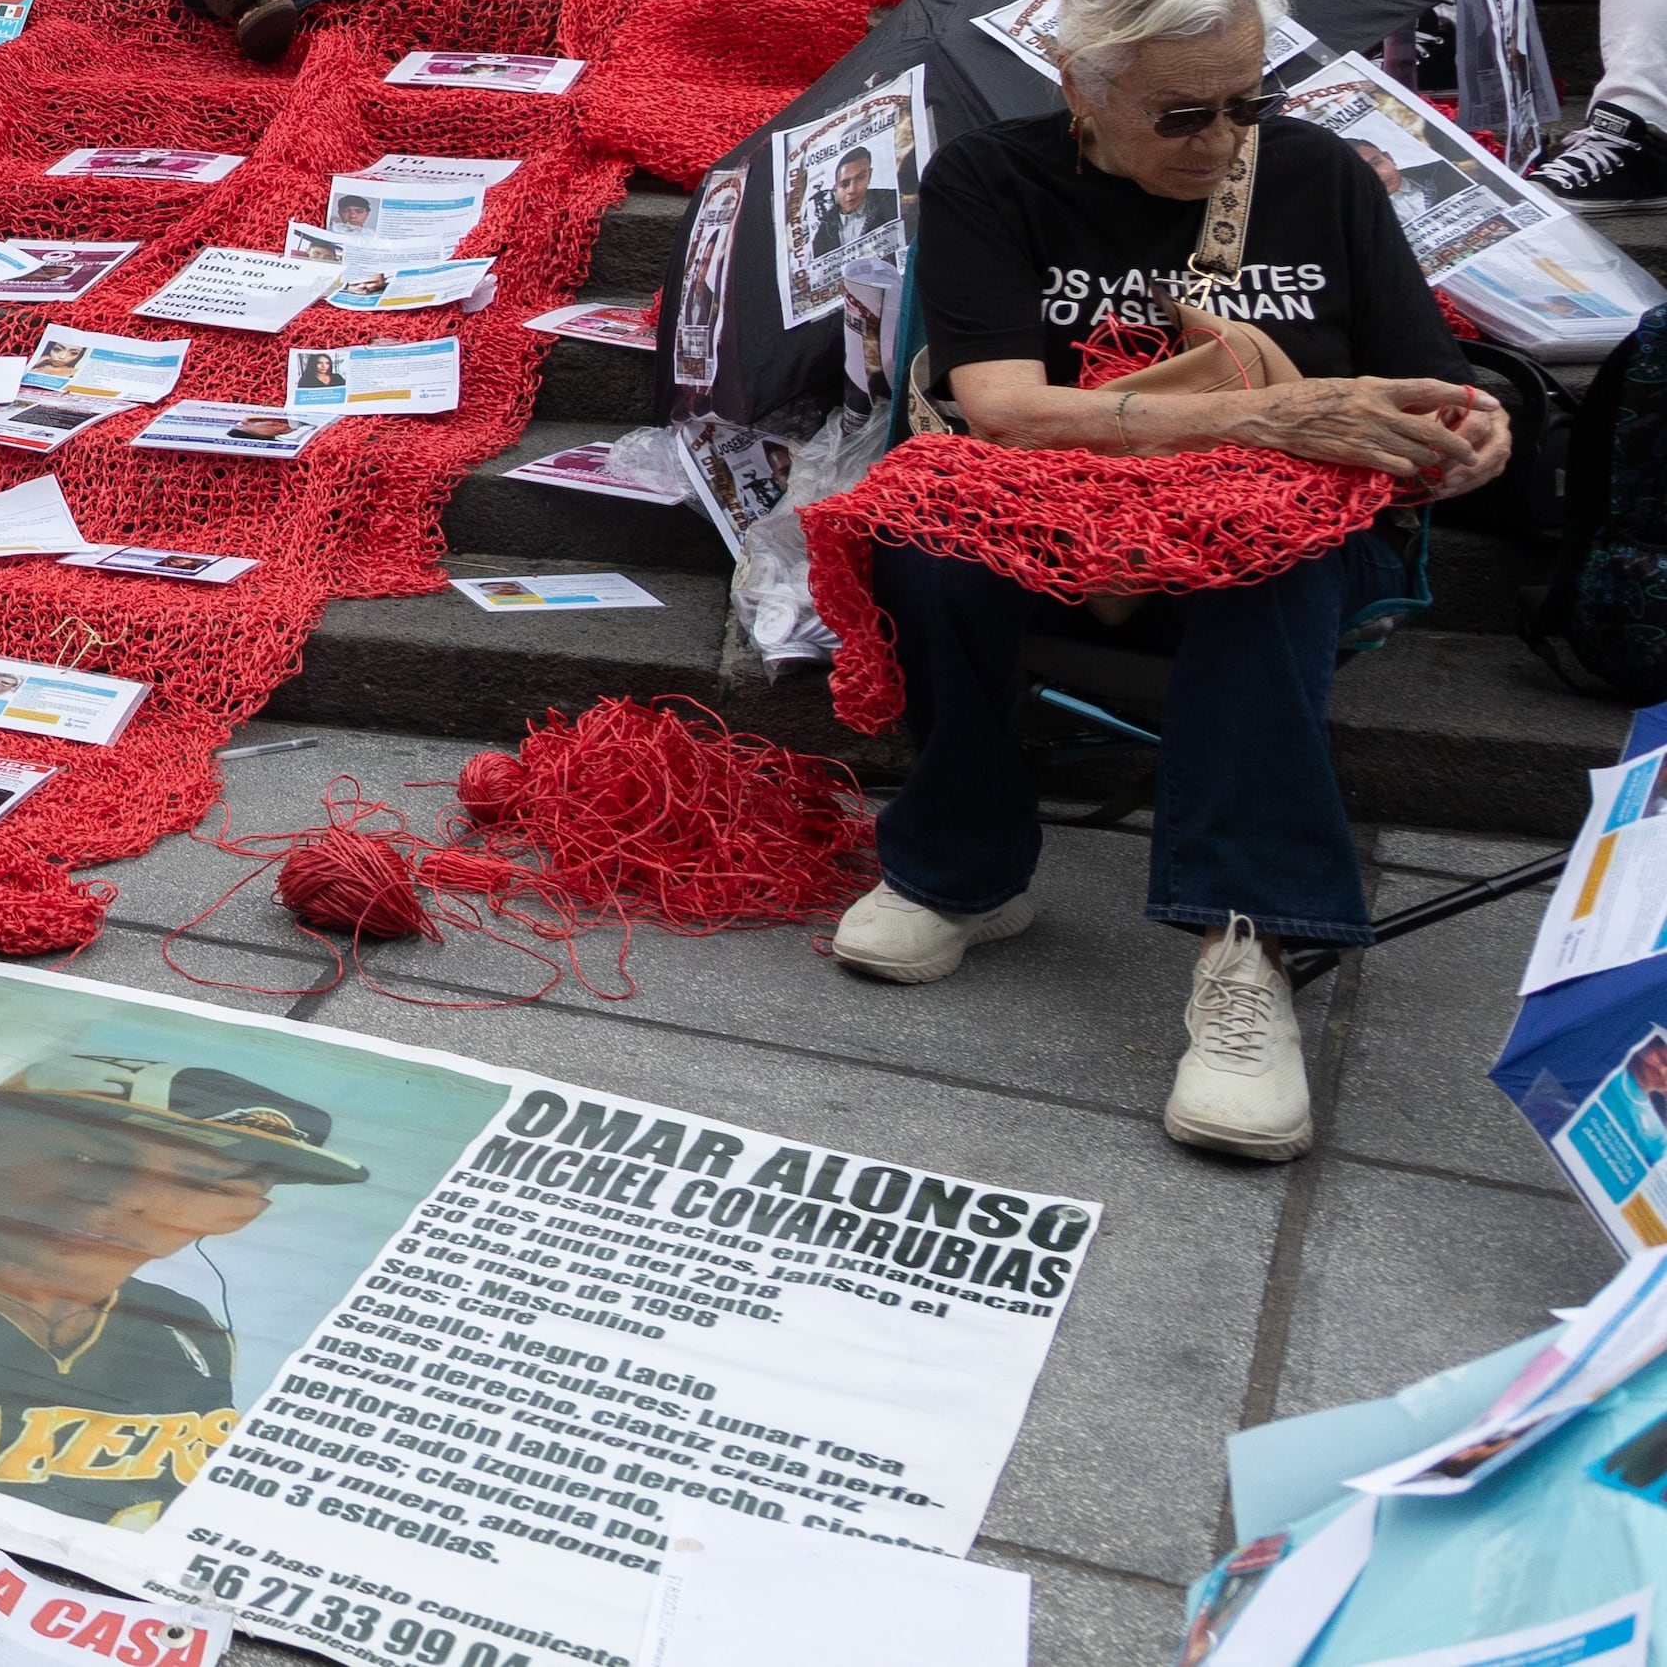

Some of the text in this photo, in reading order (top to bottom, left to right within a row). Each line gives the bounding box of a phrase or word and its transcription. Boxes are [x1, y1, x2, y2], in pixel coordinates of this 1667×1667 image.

[162, 293, 247, 308] gobierno
[174, 284, 245, 297] ¡Pinche
[186, 273, 293, 293] somos cien!
[196, 263, 266, 278] uno, no
[205, 251, 302, 271] ¡No somos
[143, 306, 192, 319] bien!
[154, 300, 248, 317] cuéntenos
[504, 1088, 1091, 1254] OMAR ALONSO
[419, 1202, 785, 1301] 30 de del 2018
[434, 1188, 951, 1319] de los membrillos, Jalisco el
[448, 1170, 1056, 1319] Fue Desaparecido en Ixtlahuacan
[468, 1134, 1073, 1301] MICHEL COVARRUBIAS
[365, 1275, 538, 1327] Ojos: Café
[380, 1257, 668, 1341] Sexo: Masculino
[394, 1237, 721, 1329] 8 de mayo de 1998
[566, 1259, 785, 1326] nacimiento:
[349, 1294, 720, 1403] Cabello: Negro Lacio
[279, 1370, 609, 1477] perforación labio
[315, 1334, 947, 1510] nasal derecho, ciatriz ceja perfo-
[332, 1312, 907, 1478] Señas particulares: Lunar fosa
[225, 1441, 470, 1526] vivo y muero,
[246, 1414, 599, 1532] tatuajes; clavícula
[264, 1396, 666, 1523] frente lado izquierdo,
[207, 1464, 502, 1566] cho 3 estrellas.
[28, 1599, 208, 1667] CASA
[185, 1526, 631, 1667] Si lo has visto comunicate
[248, 1575, 317, 1619] 27
[321, 1593, 386, 1645] 33
[384, 1617, 453, 1667] 99
